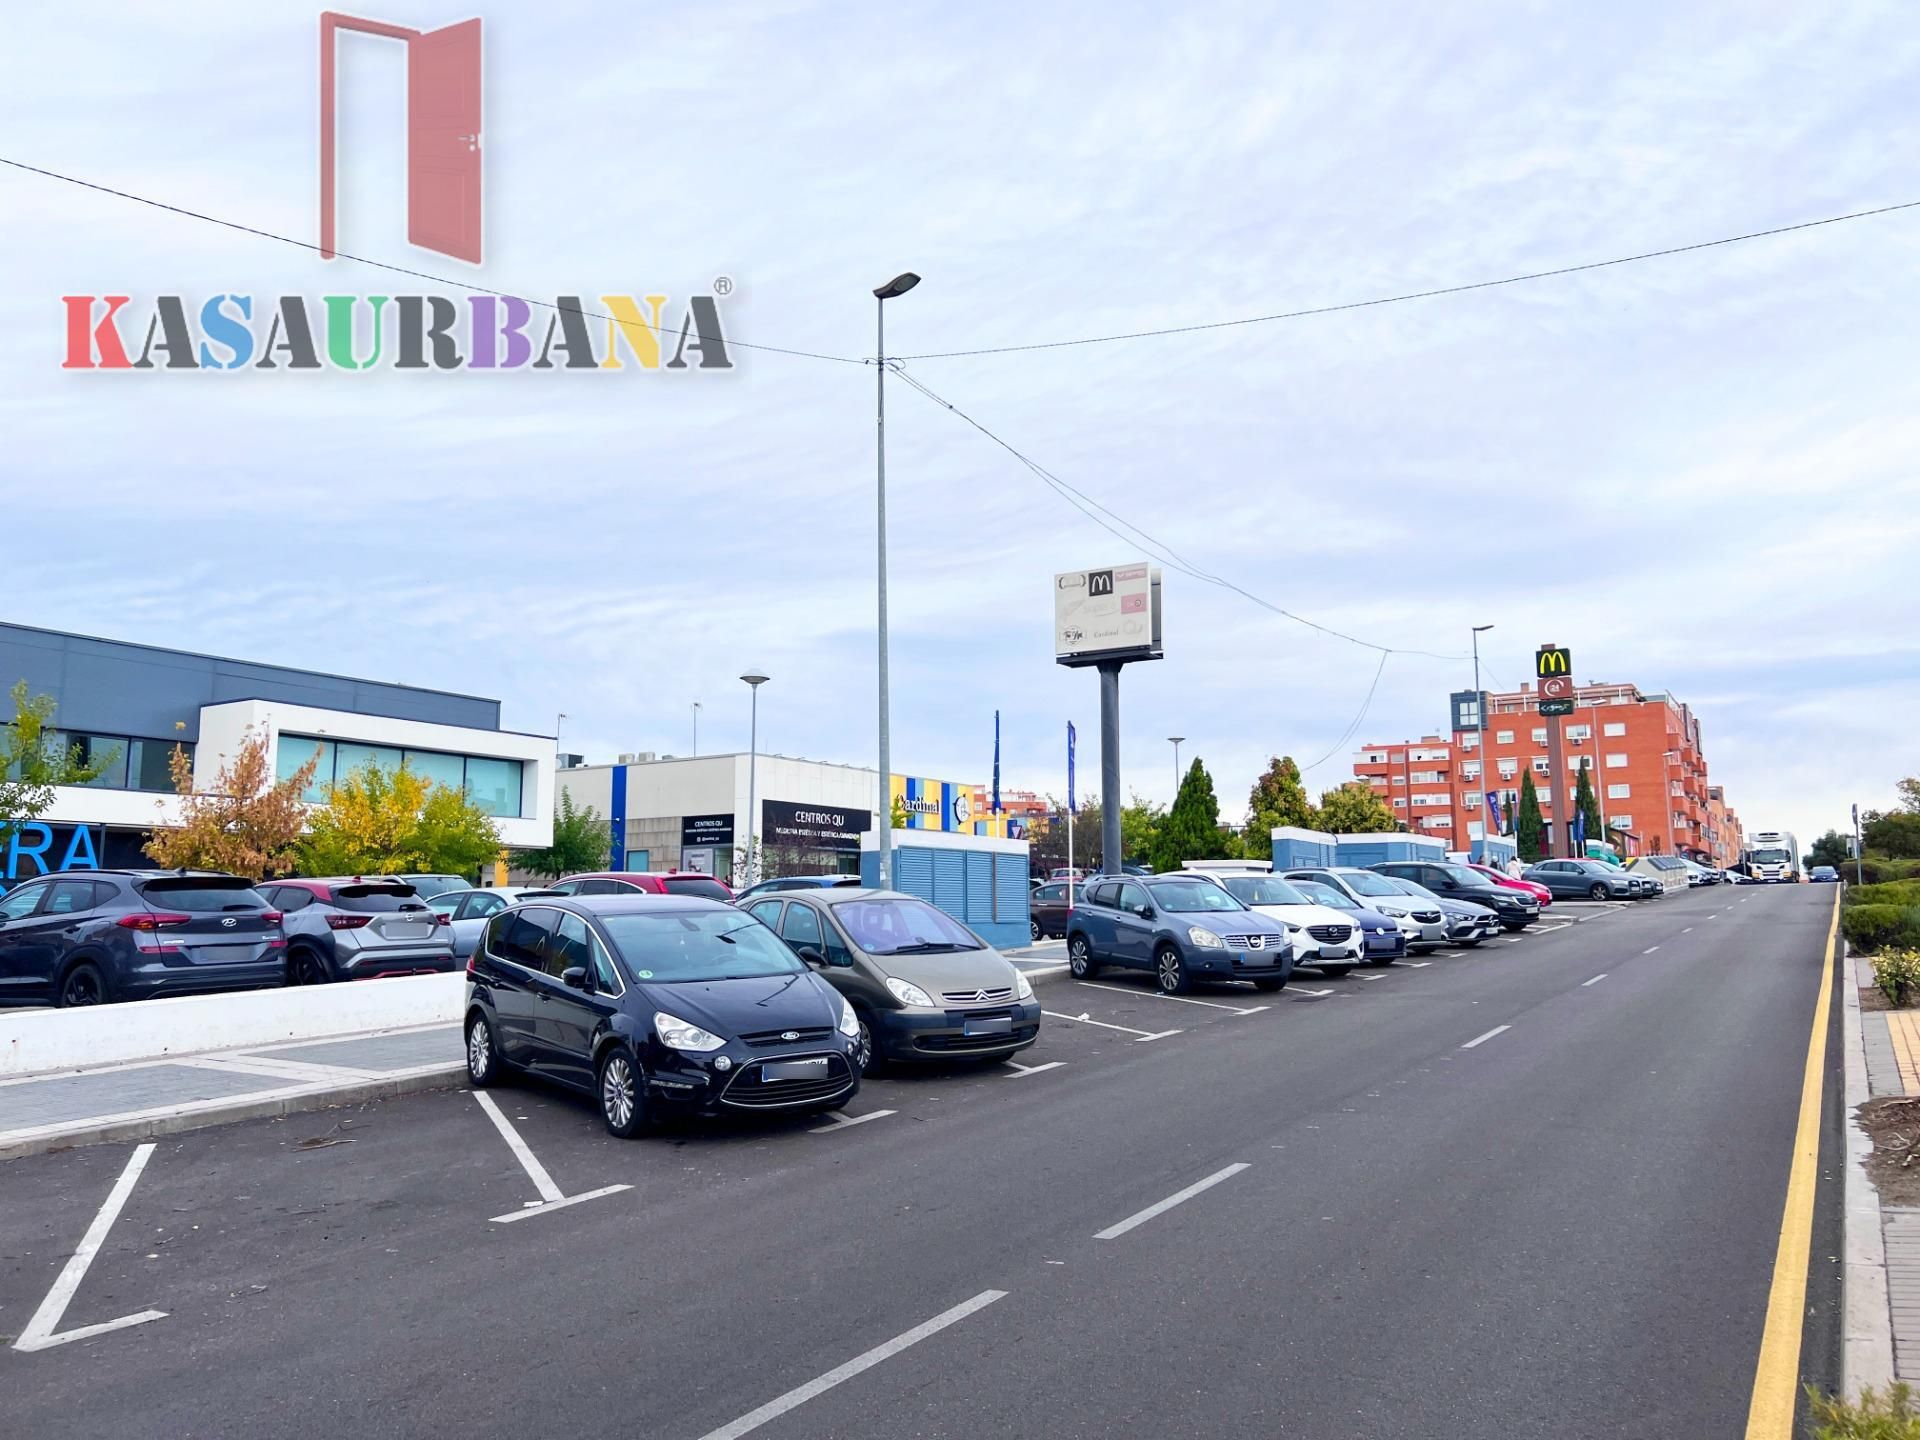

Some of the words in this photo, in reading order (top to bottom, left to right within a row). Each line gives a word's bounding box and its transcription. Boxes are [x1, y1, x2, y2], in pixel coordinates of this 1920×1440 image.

[898, 794, 940, 814] Cardinal
[795, 810, 831, 825] CENTROS
[832, 814, 845, 827] QU
